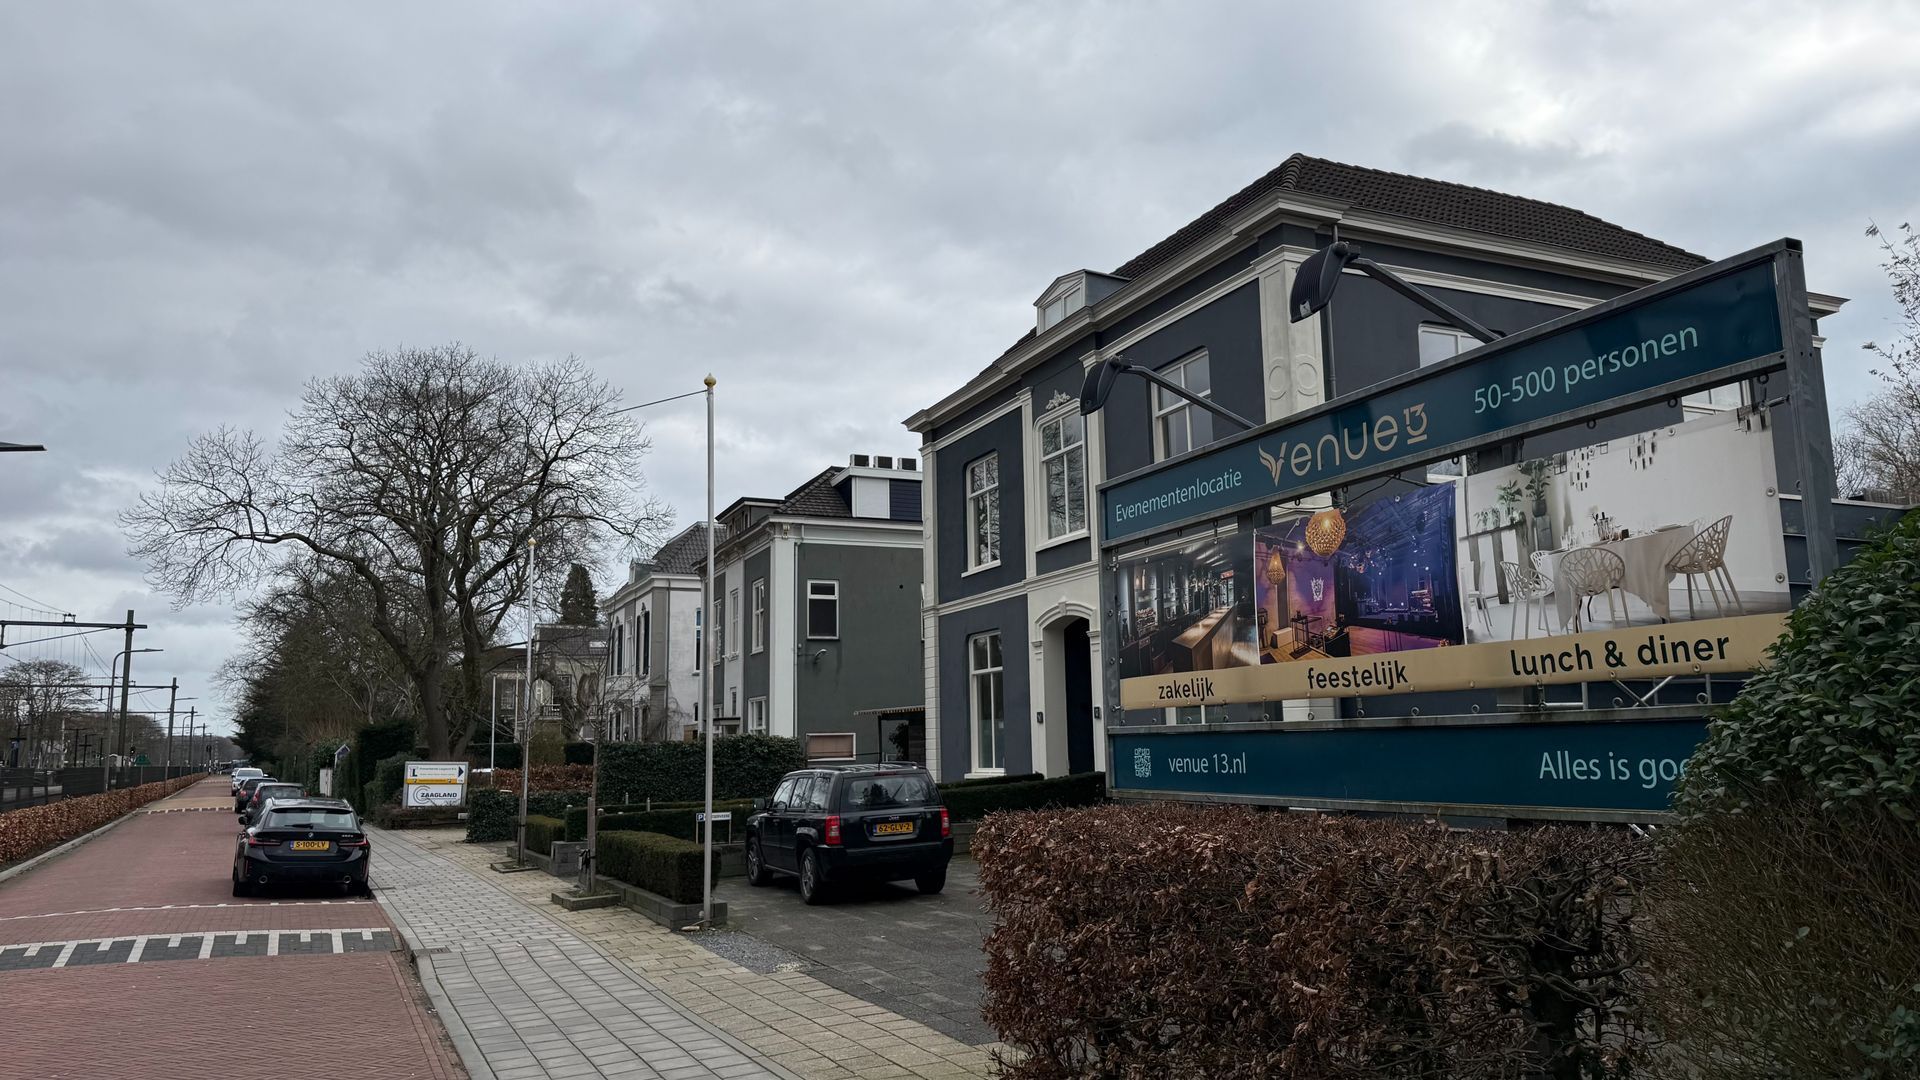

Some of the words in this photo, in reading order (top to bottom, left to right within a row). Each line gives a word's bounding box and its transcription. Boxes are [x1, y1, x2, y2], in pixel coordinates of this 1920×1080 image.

[1474, 365, 1556, 414] 50-500
[1562, 326, 1699, 393] personen
[1115, 470, 1243, 523] Evenementenlocatie
[1510, 643, 1593, 675] lunch
[1605, 640, 1627, 668] &
[1638, 635, 1730, 667] diner
[1157, 677, 1216, 702] zakelijk
[1307, 660, 1410, 690] feestelijk
[1539, 751, 1602, 780] Alles
[1608, 751, 1631, 780] is
